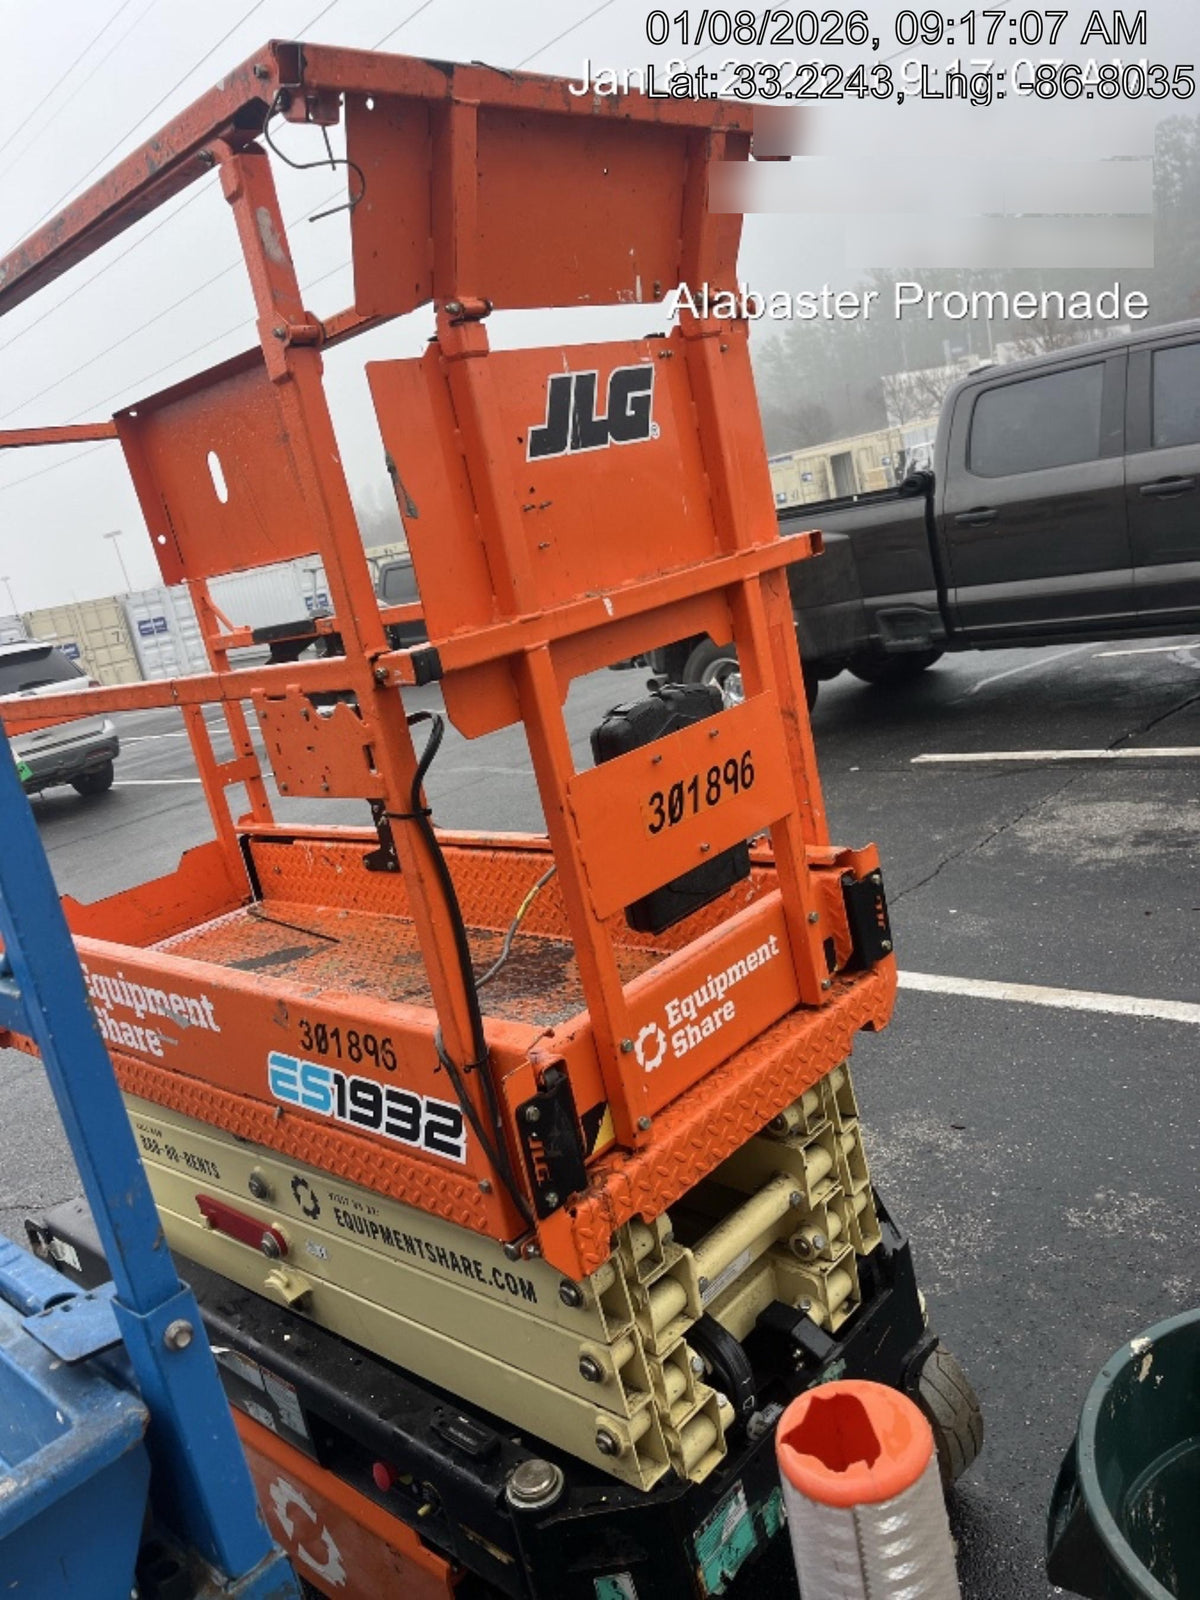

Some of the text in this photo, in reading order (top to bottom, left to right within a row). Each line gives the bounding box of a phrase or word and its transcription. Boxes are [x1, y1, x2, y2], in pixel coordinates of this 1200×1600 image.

[526, 363, 655, 462] JLG
[648, 750, 755, 835] 301896
[664, 934, 780, 1030] Equipment
[671, 1000, 736, 1059] Share
[298, 1019, 397, 1071] 301896
[268, 1051, 466, 1165] ES1932
[333, 1207, 538, 1304] EQUIPMENTSHARE.COM
